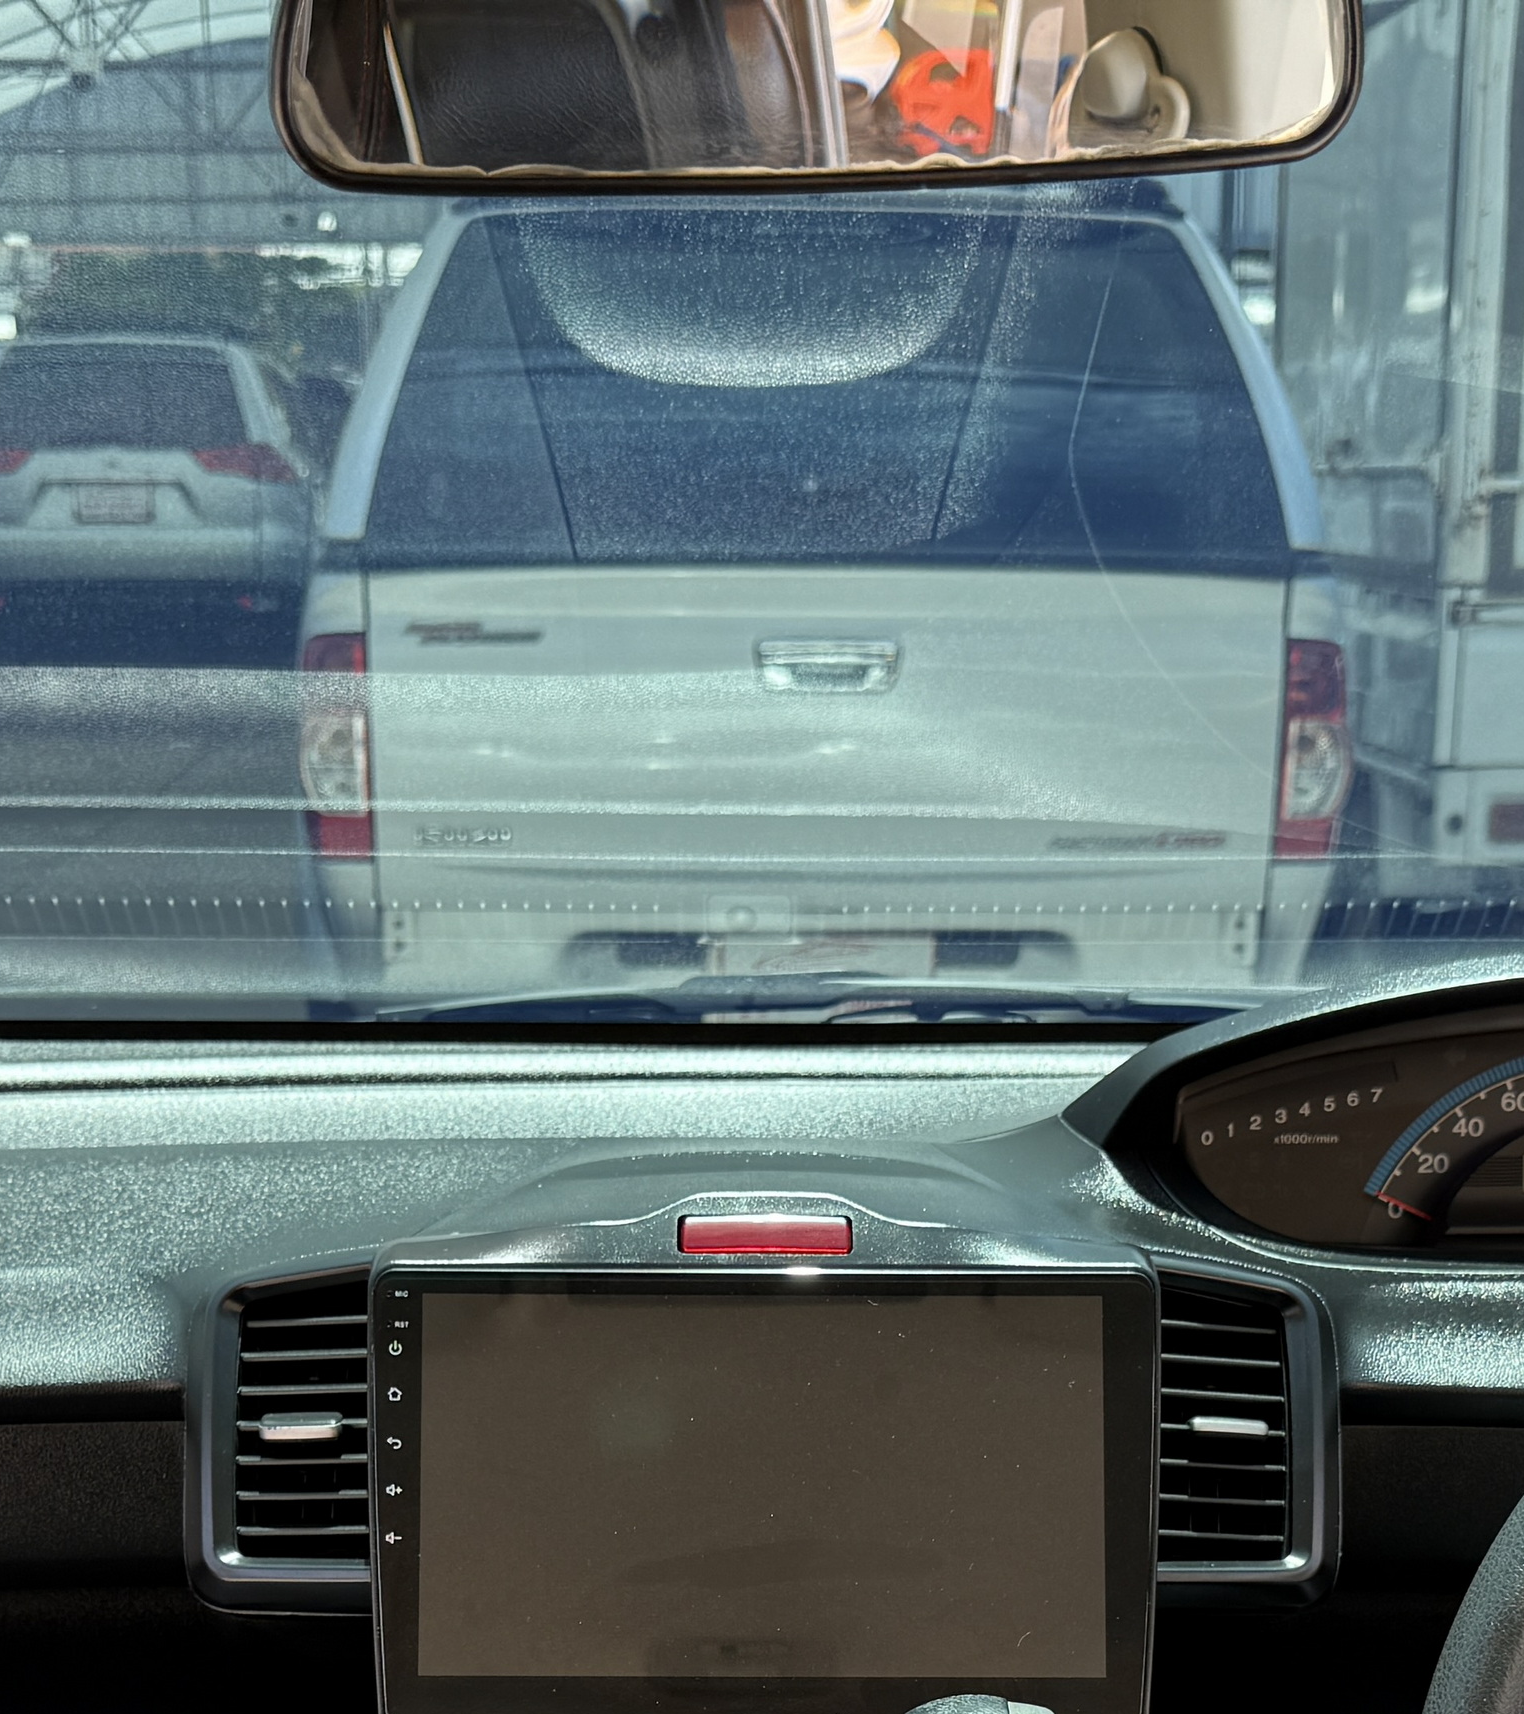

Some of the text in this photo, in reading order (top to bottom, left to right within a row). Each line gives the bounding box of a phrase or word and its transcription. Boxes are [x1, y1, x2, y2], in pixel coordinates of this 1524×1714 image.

[1201, 1130, 1213, 1145] 0
[1249, 1115, 1262, 1130] 2
[1275, 1109, 1288, 1124] 3
[1299, 1102, 1311, 1117] 4
[1323, 1096, 1336, 1112] 5
[1347, 1092, 1359, 1107] 6
[1371, 1088, 1384, 1102] 7
[1453, 1118, 1484, 1138] 40
[1418, 1154, 1449, 1174] 20
[1388, 1201, 1402, 1218] 0
